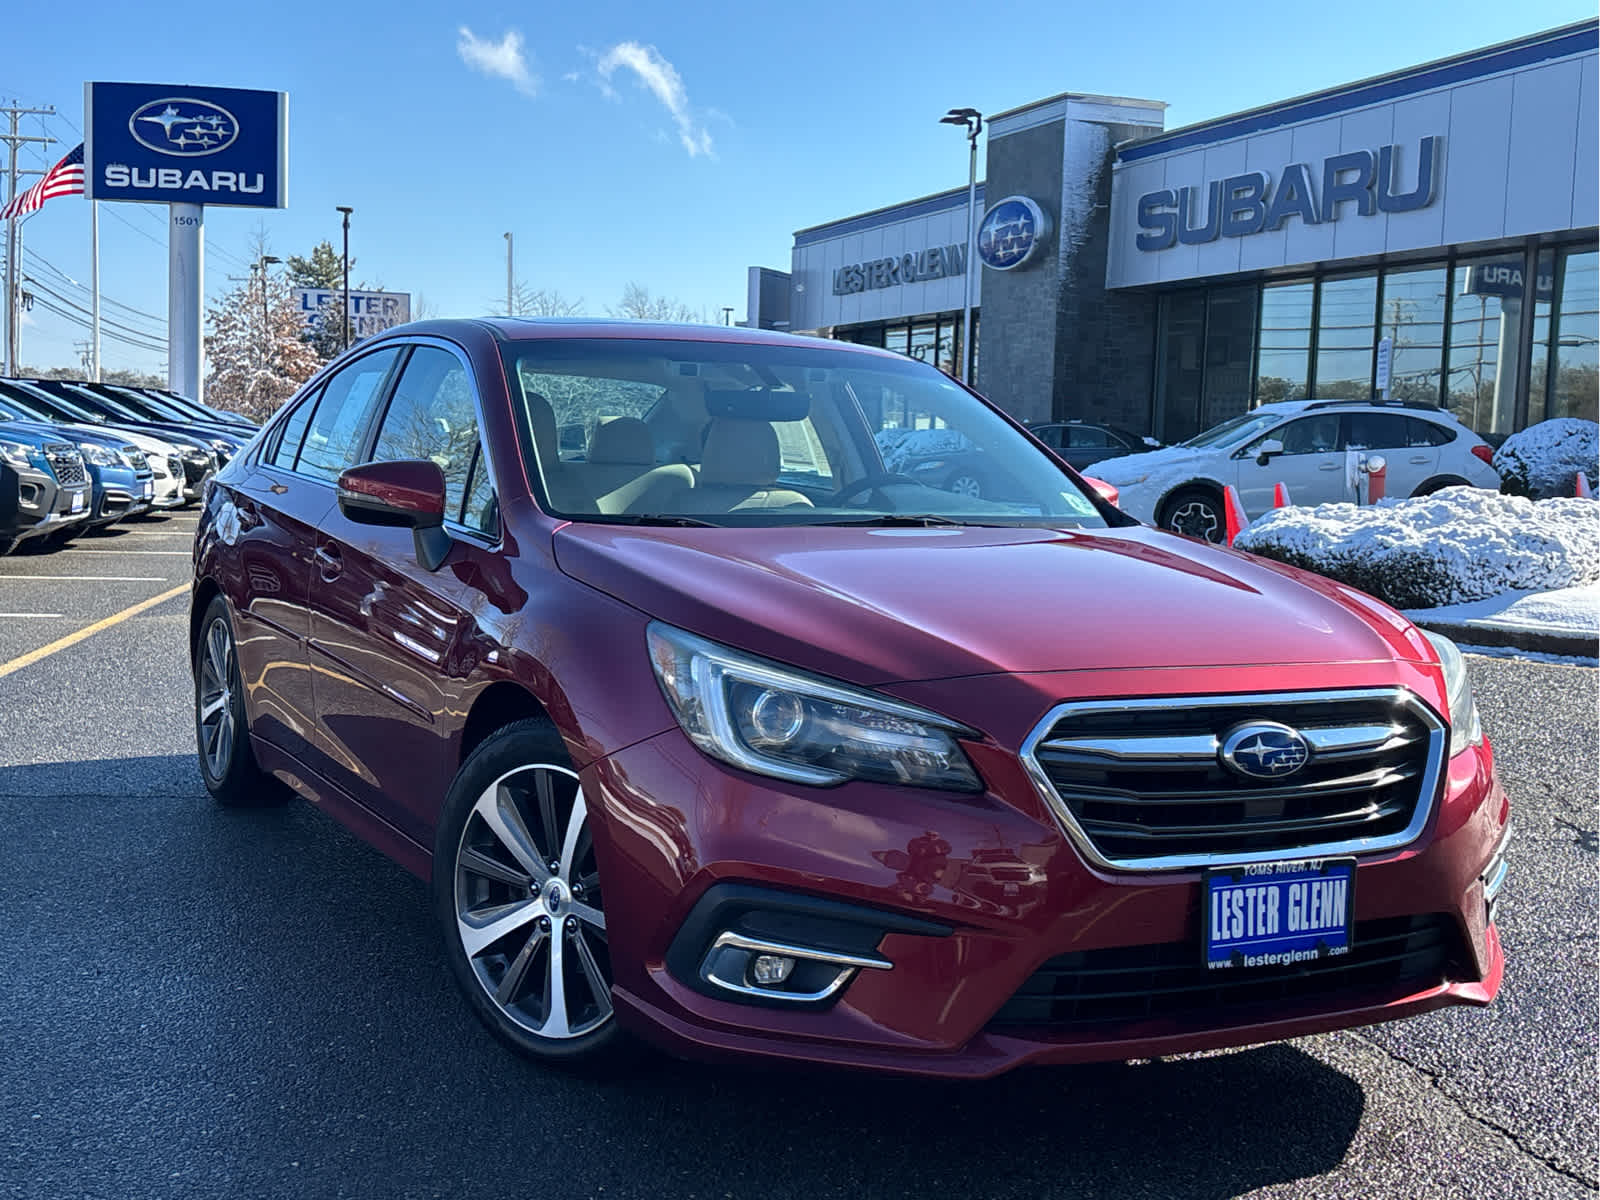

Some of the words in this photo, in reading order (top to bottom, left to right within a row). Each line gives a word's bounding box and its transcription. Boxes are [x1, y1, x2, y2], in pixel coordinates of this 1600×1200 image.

[105, 165, 264, 193] SUBARU
[1136, 136, 1439, 252] SUBARU
[174, 216, 199, 226] 1501
[832, 256, 899, 296] LESTER
[302, 293, 400, 316] LETER
[1244, 864, 1273, 876] TOMS
[1309, 860, 1324, 871] NJ
[1211, 886, 1280, 941] LESTER
[1288, 880, 1347, 932] GLENN
[1208, 959, 1234, 970] www.
[1244, 949, 1319, 967] lesterglenn
[1327, 946, 1348, 956] .com
